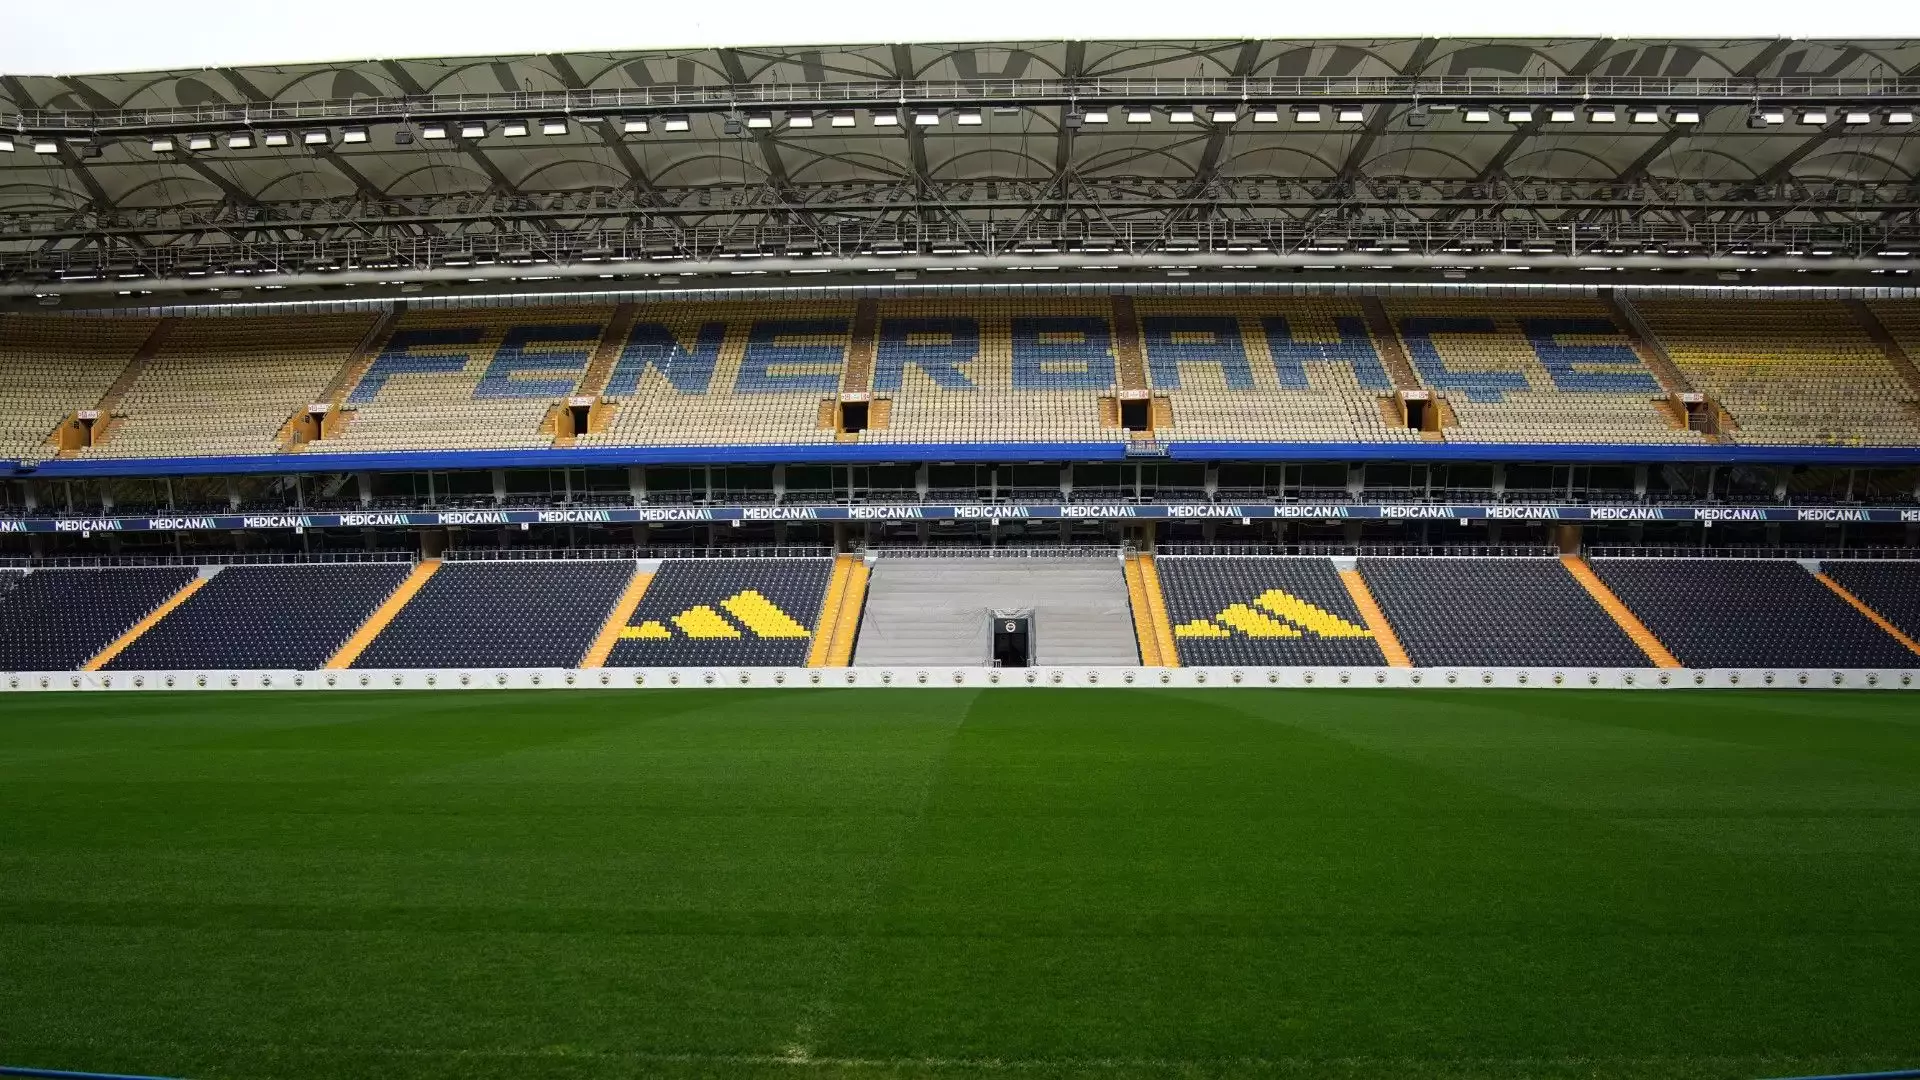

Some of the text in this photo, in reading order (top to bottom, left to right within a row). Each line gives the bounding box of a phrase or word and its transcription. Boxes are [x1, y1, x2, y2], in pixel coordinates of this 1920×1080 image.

[348, 314, 1664, 404] FENERBAHÇE
[538, 511, 601, 522] MEDICANA
[639, 509, 703, 520] MEDICANA
[742, 508, 808, 519] MEDICANA
[848, 507, 915, 518] MEDICANA
[954, 507, 1021, 518] MEDICANA
[1060, 507, 1128, 518] MEDICANA
[1167, 507, 1234, 518] MEDICANA
[1273, 507, 1341, 518] MEDICANA
[1379, 507, 1446, 518] MEDICANA
[1485, 507, 1552, 518] MEDICANA
[1590, 508, 1656, 519] MEDICANA
[1694, 509, 1760, 520] MEDICANA
[1798, 510, 1862, 520] MEDICANA
[149, 518, 207, 529] MEDICANA
[243, 516, 303, 528] MEDICANA
[340, 514, 401, 526] MEDICANA
[438, 513, 500, 524] MEDICANA
[55, 520, 115, 531] MEDICANA
